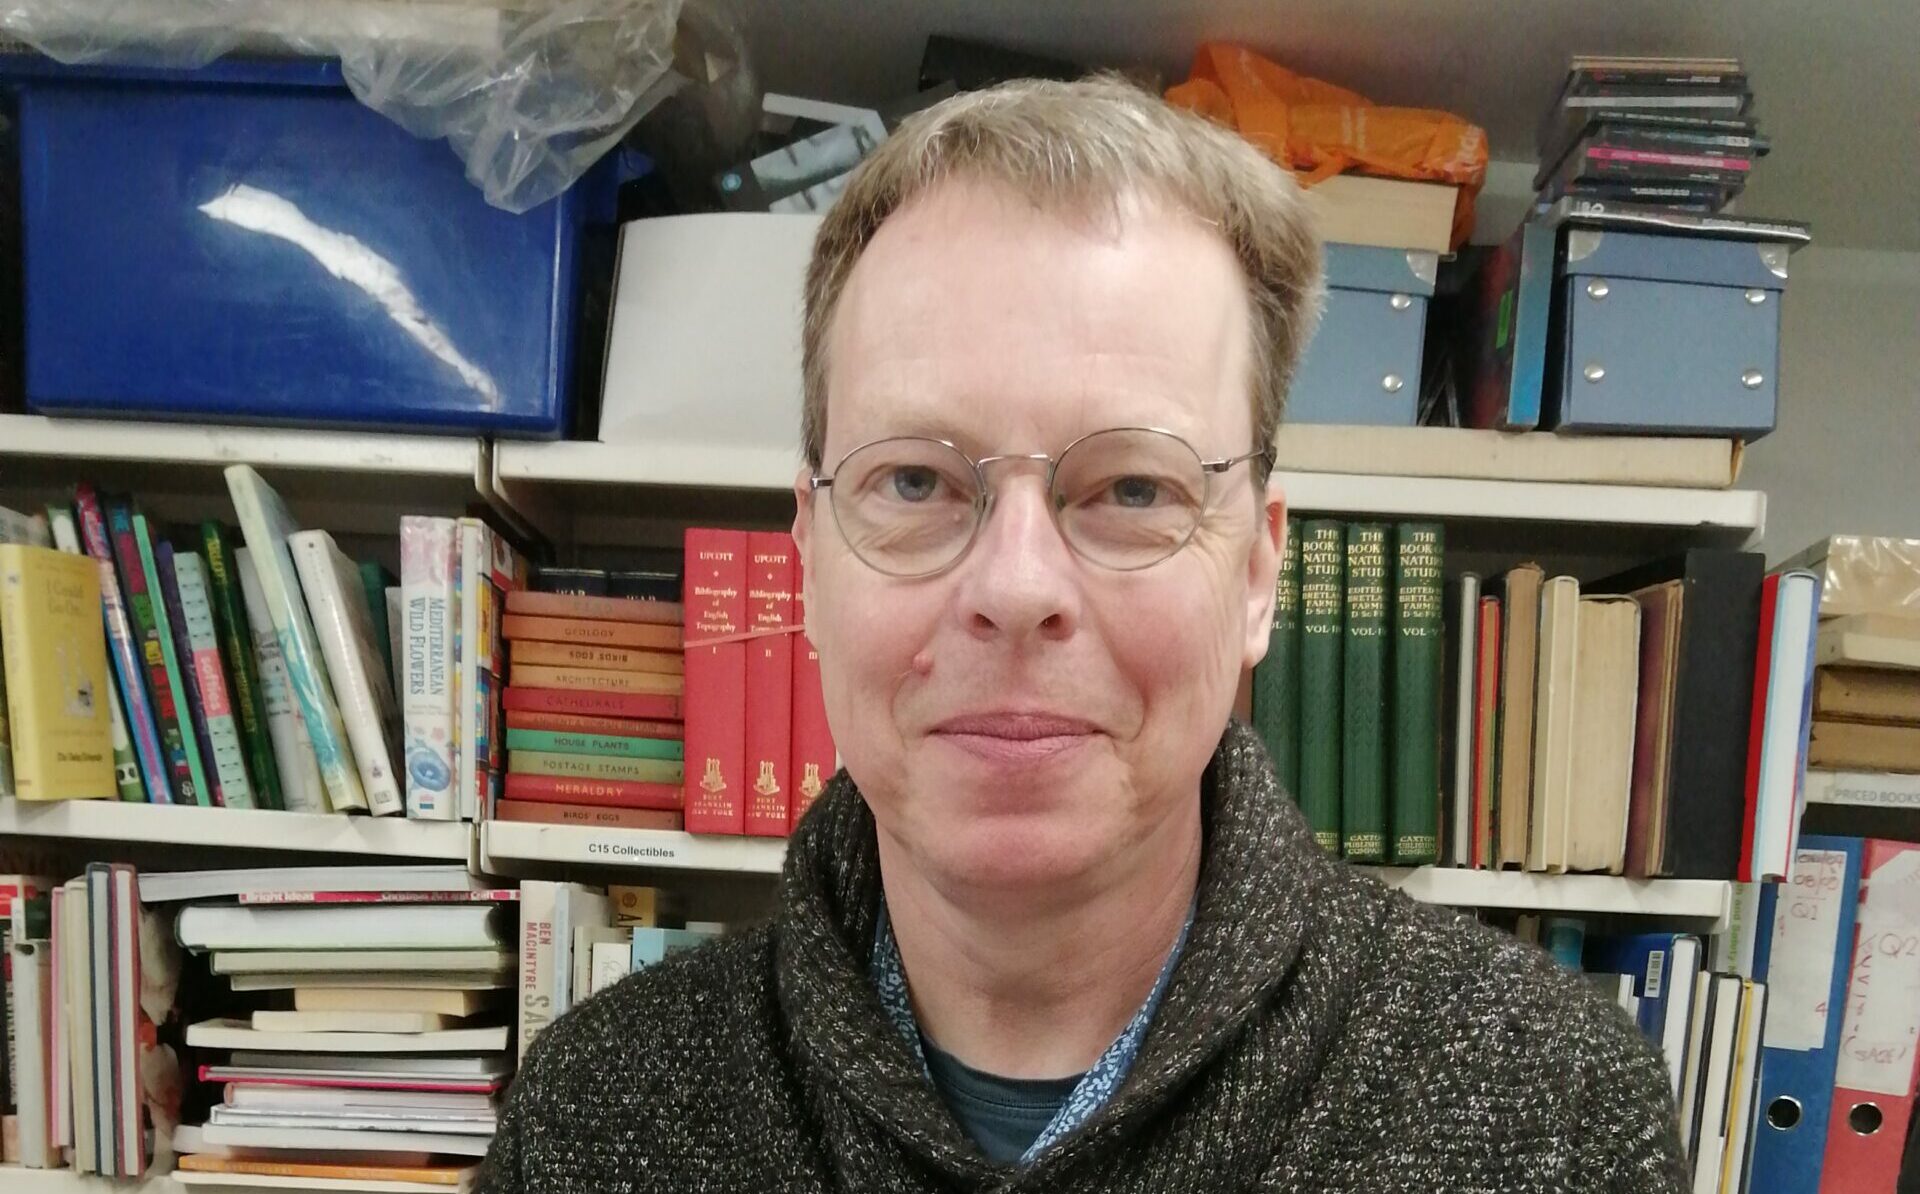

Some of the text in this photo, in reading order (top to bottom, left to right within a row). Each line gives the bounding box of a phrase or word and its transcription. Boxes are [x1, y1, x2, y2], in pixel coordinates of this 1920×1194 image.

[1413, 531, 1436, 543] THE
[1302, 541, 1335, 552] BOOK
[1347, 543, 1380, 555] BOOK
[1400, 544, 1433, 555] BOOK
[699, 551, 734, 561] UPCOTT
[754, 554, 788, 564] UPCOTT
[564, 627, 616, 638] GEOLOGY
[409, 597, 425, 695] WILD FLOWERS
[429, 597, 445, 695] MEDITERRANEAN
[556, 674, 630, 687] ARCHITECTURE
[554, 737, 630, 750] HOUSE PLANTS
[542, 759, 640, 775] POSTAGE STAMPS
[555, 783, 625, 796] HERALDRY
[1835, 788, 1878, 801] PRICED
[596, 812, 621, 822] EGGS
[588, 843, 675, 858] C15 Collectibles
[539, 921, 552, 946] BEN
[525, 921, 538, 991] MACINTYRE
